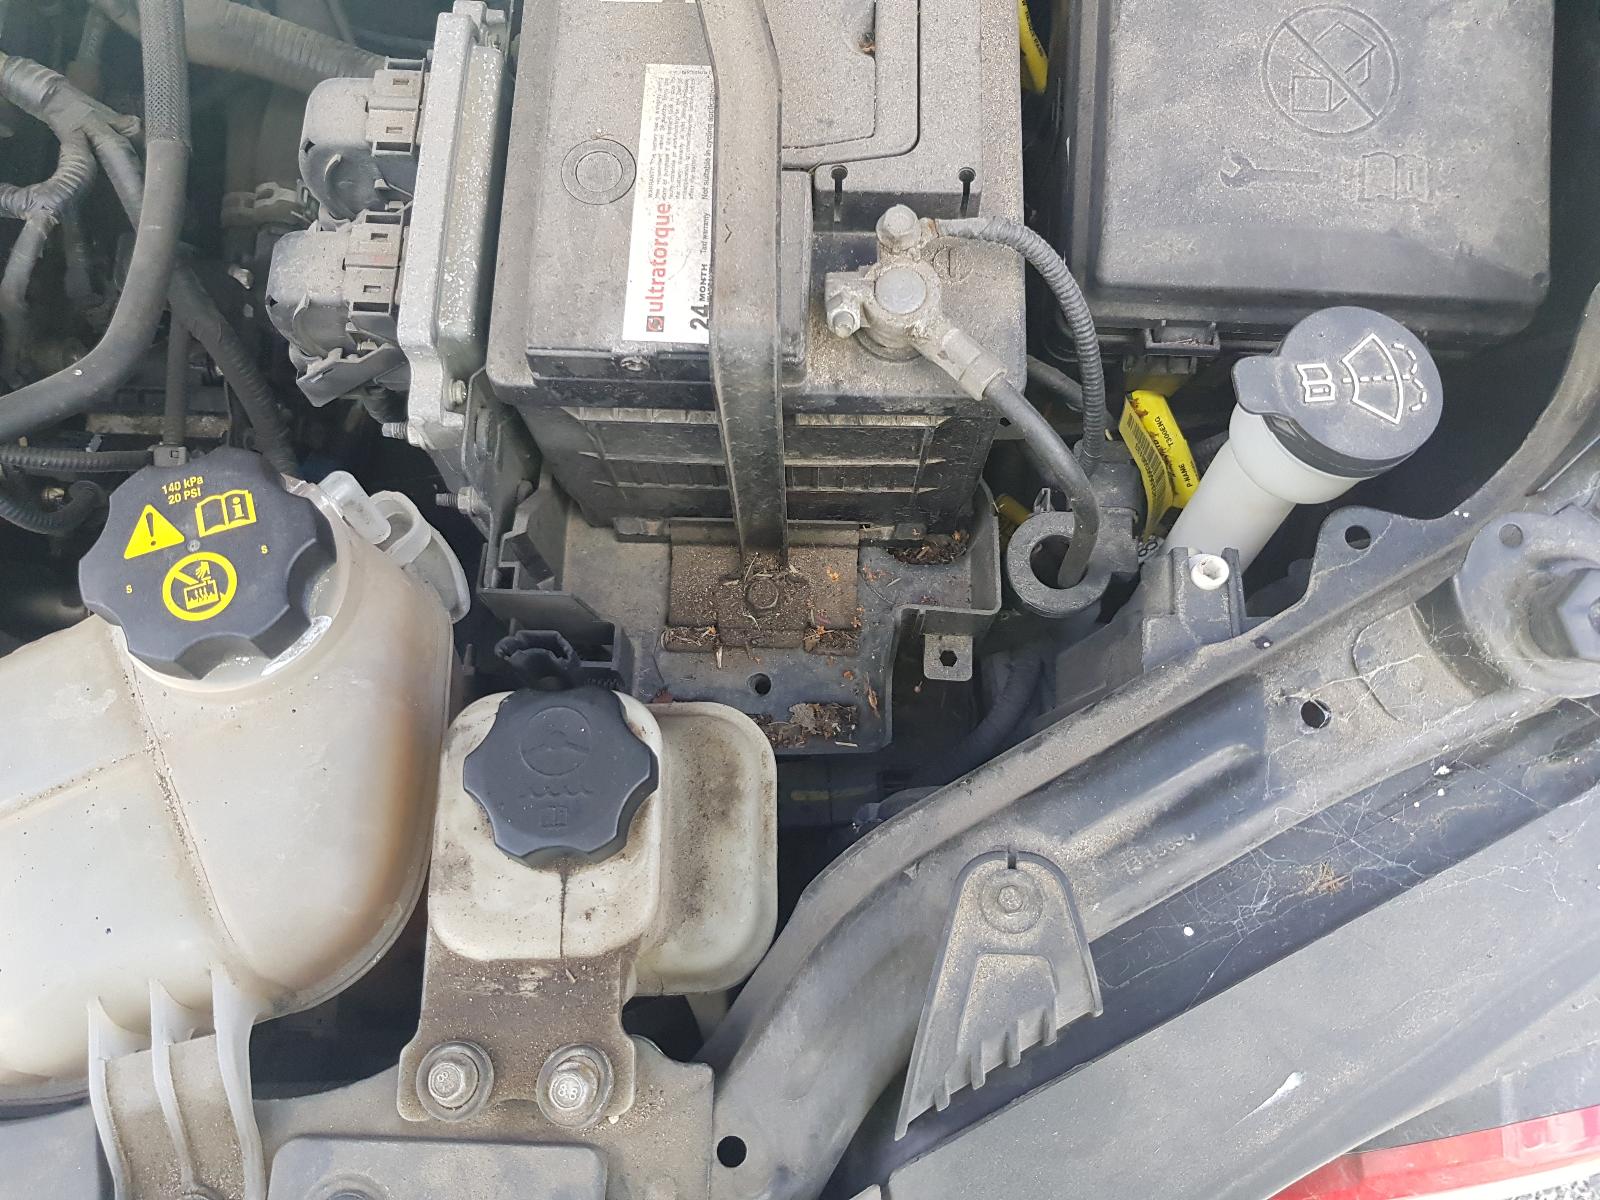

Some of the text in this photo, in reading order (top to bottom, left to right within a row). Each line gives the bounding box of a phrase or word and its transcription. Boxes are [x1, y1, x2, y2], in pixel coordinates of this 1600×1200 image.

[706, 124, 714, 148] cycling
[703, 157, 711, 185] suitable
[701, 186, 709, 200] Not
[702, 212, 711, 240] warranty
[645, 203, 675, 312] ultratorque
[690, 263, 709, 330] 24 MONTH
[161, 476, 204, 495] 140 kPa
[168, 487, 202, 505] 20 PSI
